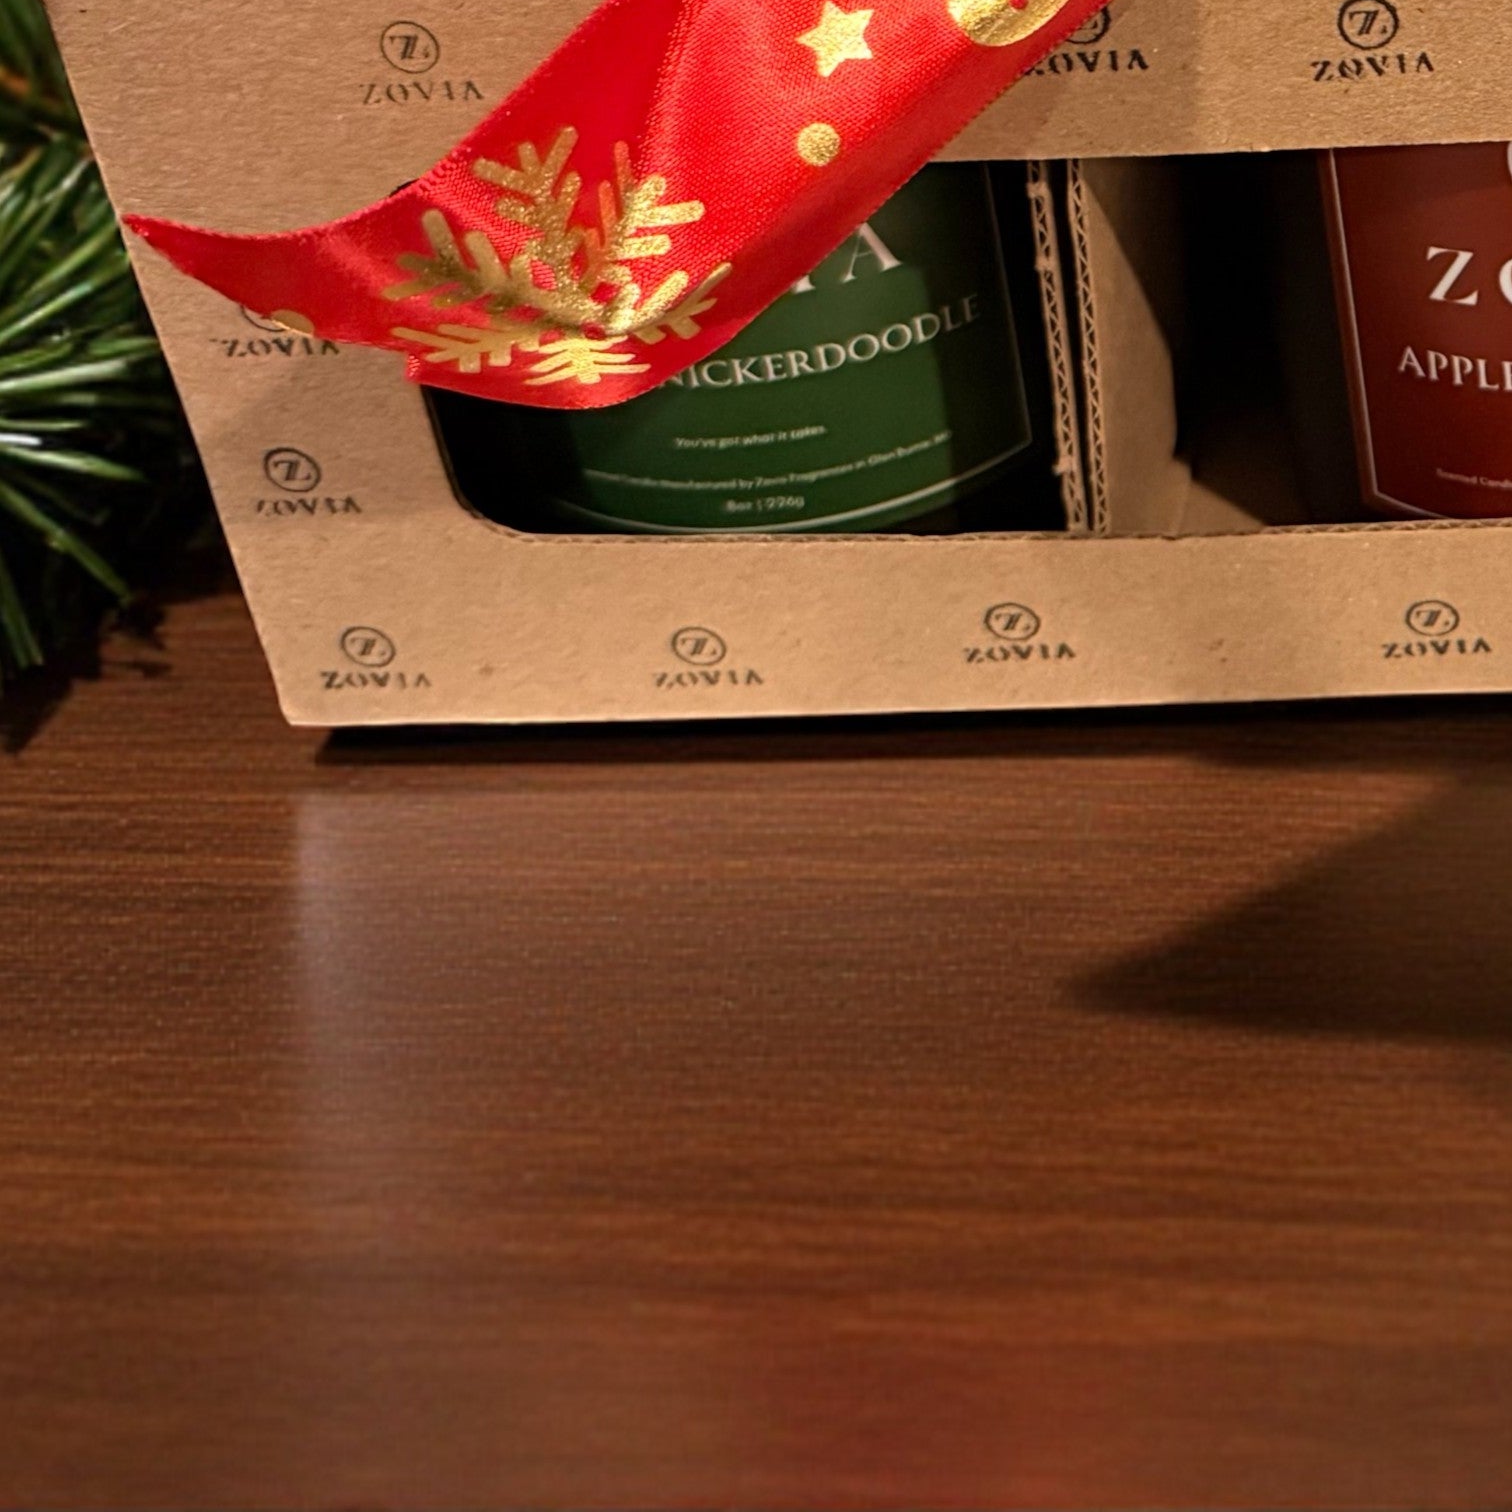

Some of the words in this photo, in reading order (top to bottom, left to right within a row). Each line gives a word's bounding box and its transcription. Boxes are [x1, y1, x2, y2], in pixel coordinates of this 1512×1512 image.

[1310, 51, 1434, 82] ZOVIA
[359, 79, 485, 106] ZOVIA
[963, 642, 1076, 663] ZOVIA
[1381, 637, 1492, 658] ZOVIA
[320, 670, 431, 690] ZOVIA
[653, 669, 763, 689] ZOVIA
